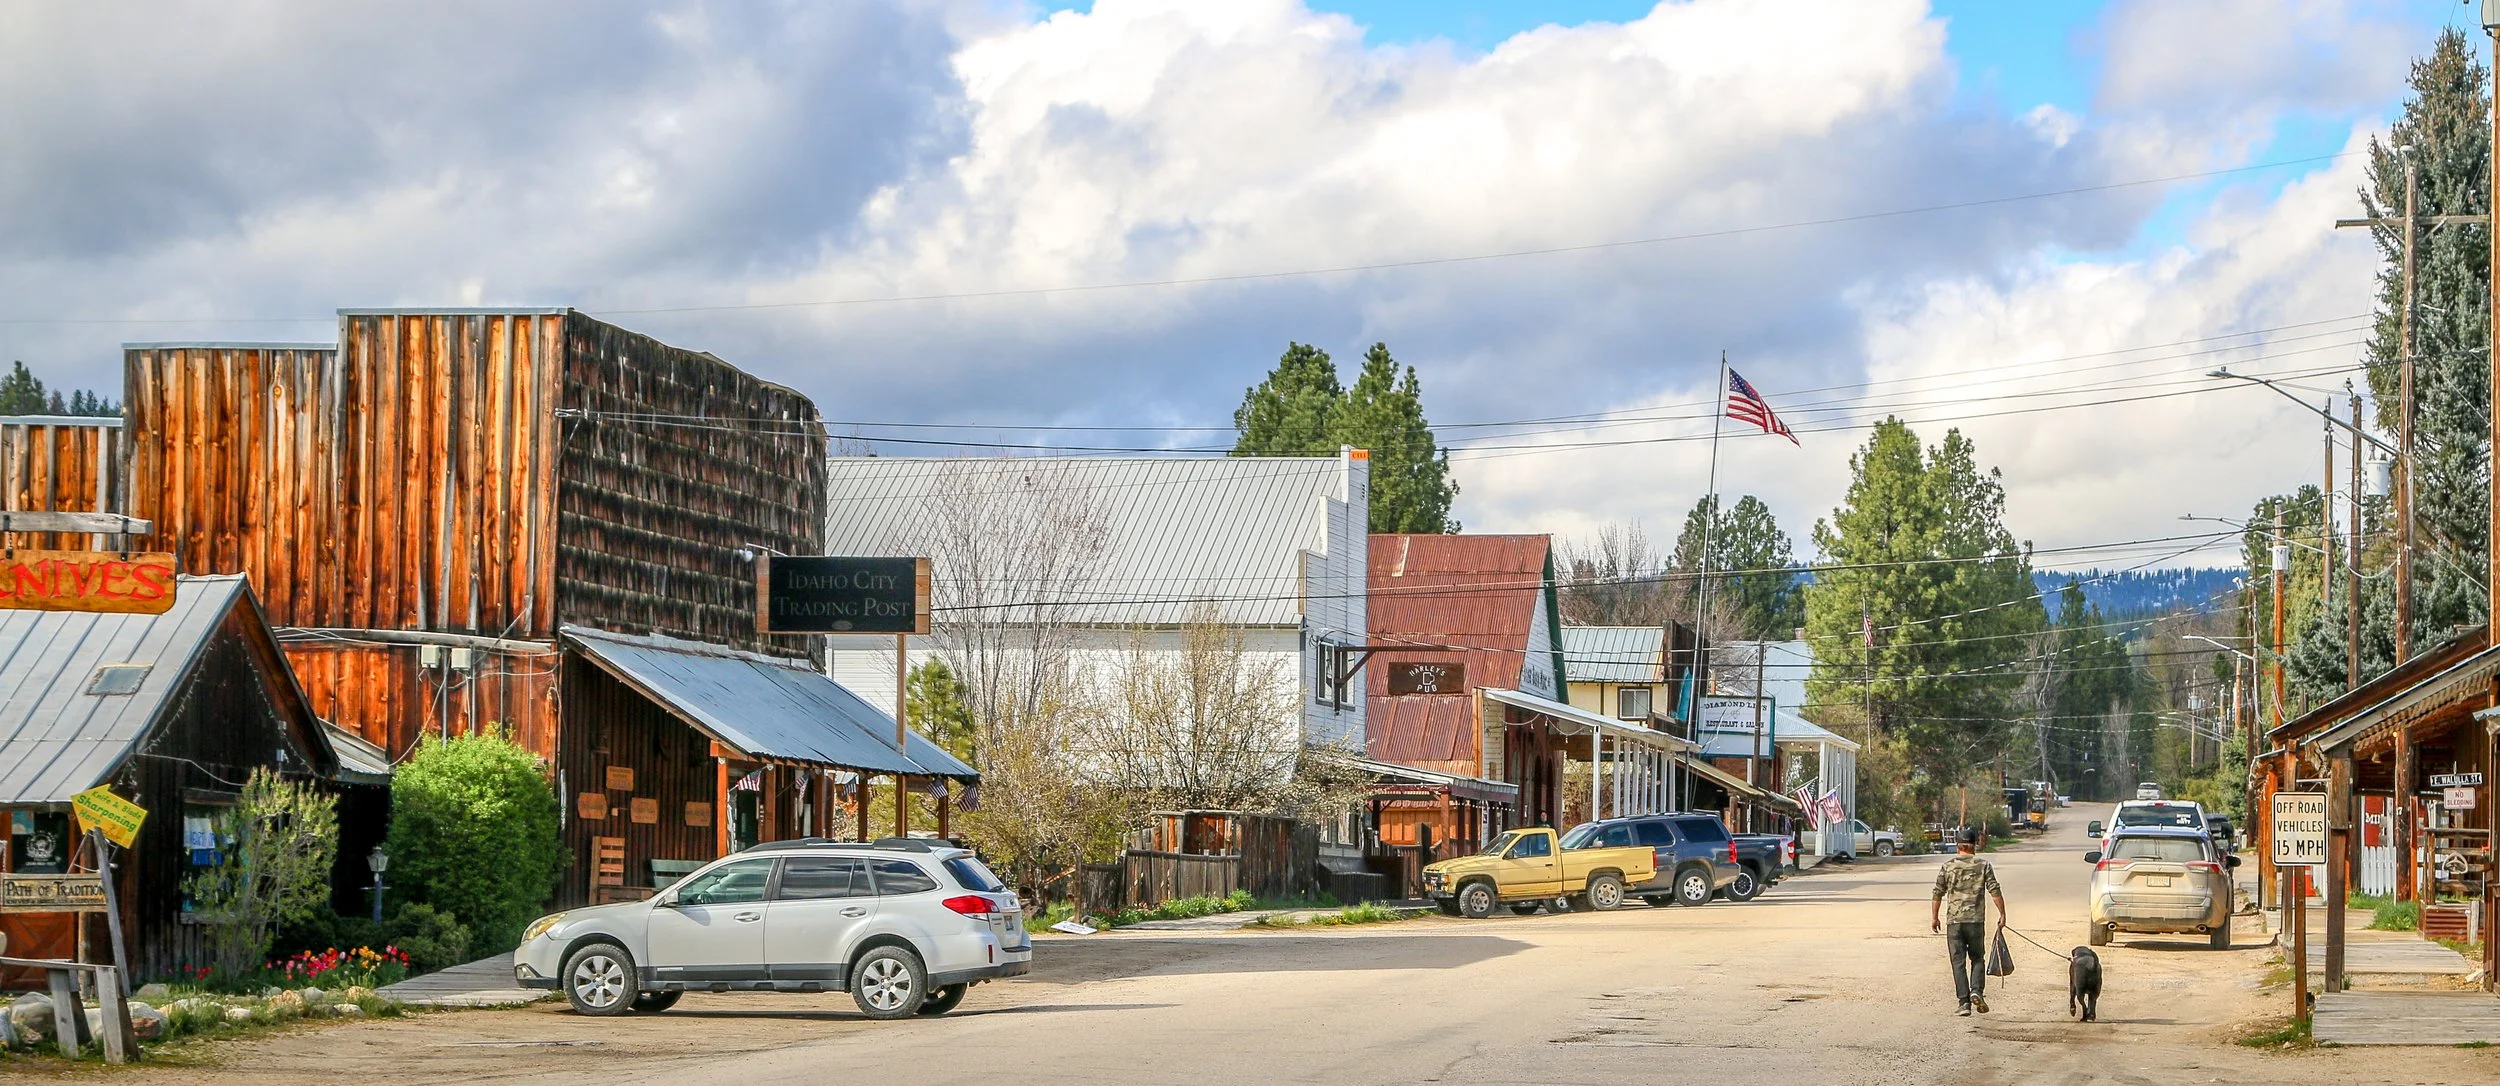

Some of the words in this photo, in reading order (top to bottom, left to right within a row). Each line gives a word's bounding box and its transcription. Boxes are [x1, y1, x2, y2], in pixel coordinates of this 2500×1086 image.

[788, 569, 848, 590] IDAHO
[853, 570, 898, 590] CITY
[774, 597, 858, 616] TRADING
[863, 597, 910, 617] POST
[1408, 665, 1446, 677] HARLEY'S
[1416, 684, 1438, 693] PUB
[1704, 701, 1745, 709] DIAMOND
[92, 790, 112, 804] Knife
[121, 805, 142, 819] Blade
[2276, 801, 2294, 813] OFF
[2298, 801, 2324, 814] ROAD
[77, 794, 137, 832] Sharpening
[79, 809, 101, 825] Here
[2276, 820, 2323, 832] VEHICLES
[2276, 839, 2290, 856] 15
[2296, 839, 2324, 856] MPH
[5, 881, 32, 897] PATH
